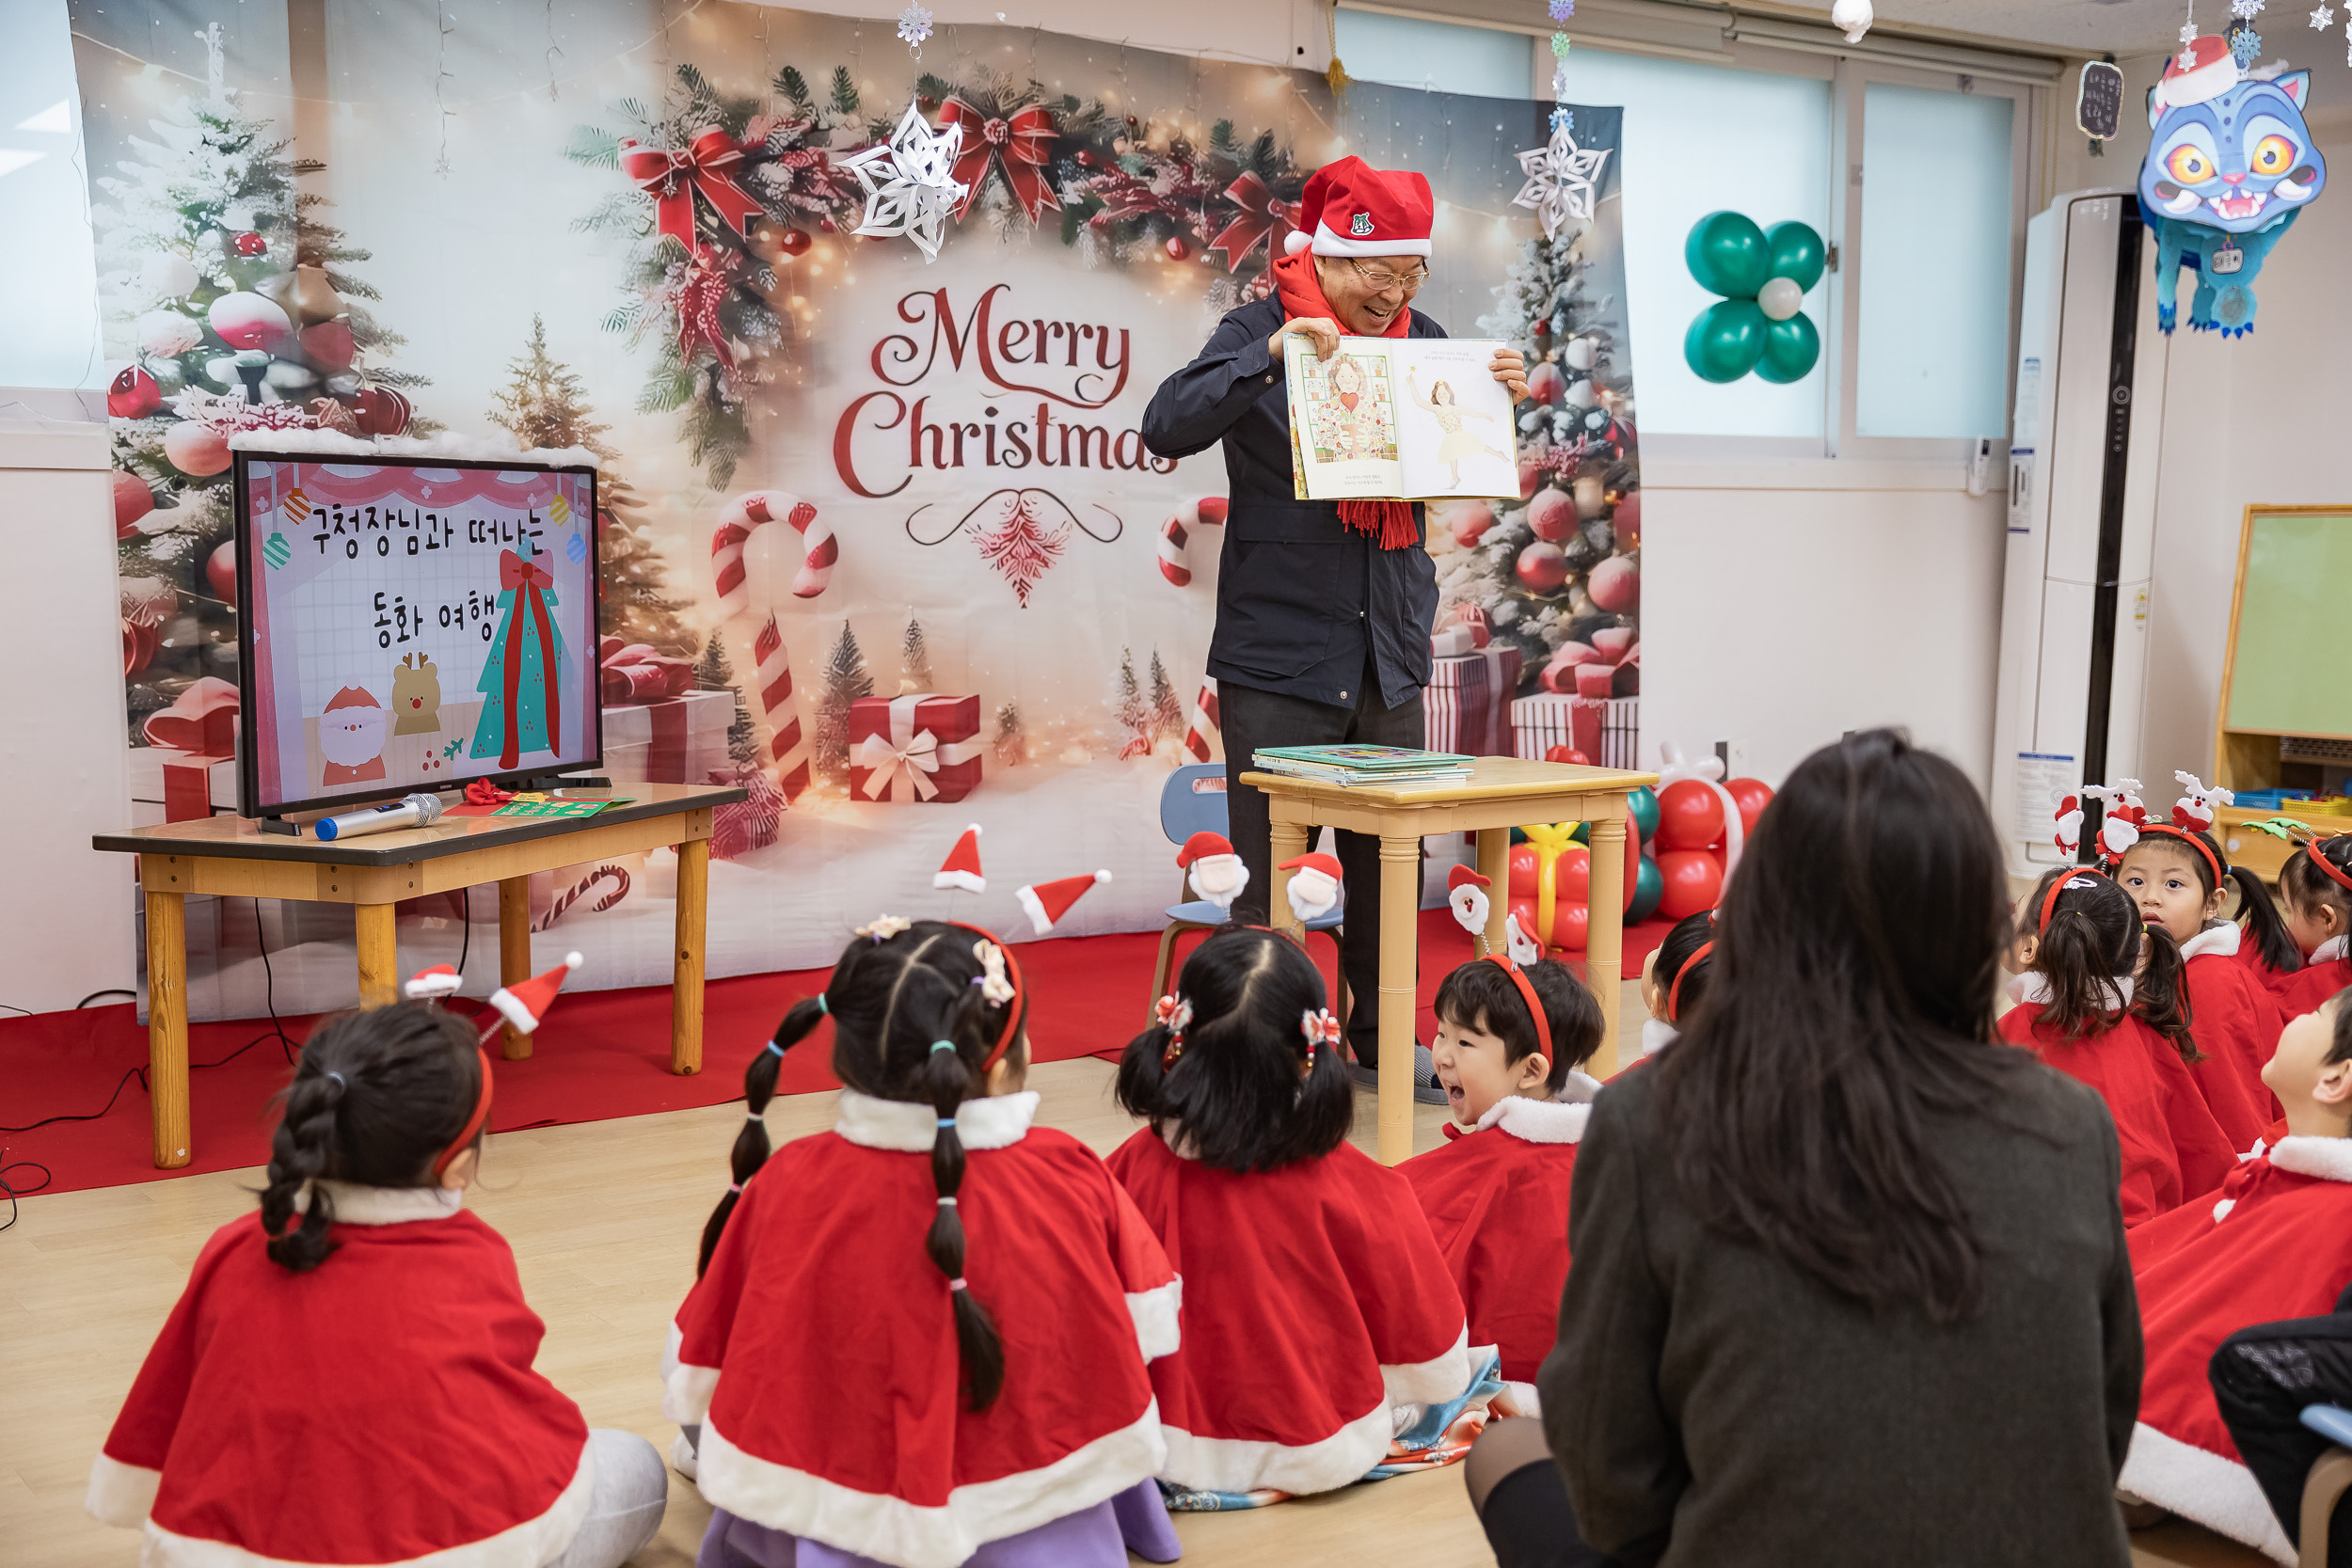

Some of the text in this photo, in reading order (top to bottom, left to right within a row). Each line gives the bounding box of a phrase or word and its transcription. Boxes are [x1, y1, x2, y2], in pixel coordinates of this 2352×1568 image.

[871, 284, 1130, 409] Merry
[312, 503, 544, 560] 구청장님과 떠나는
[373, 590, 495, 649] 동화 여행
